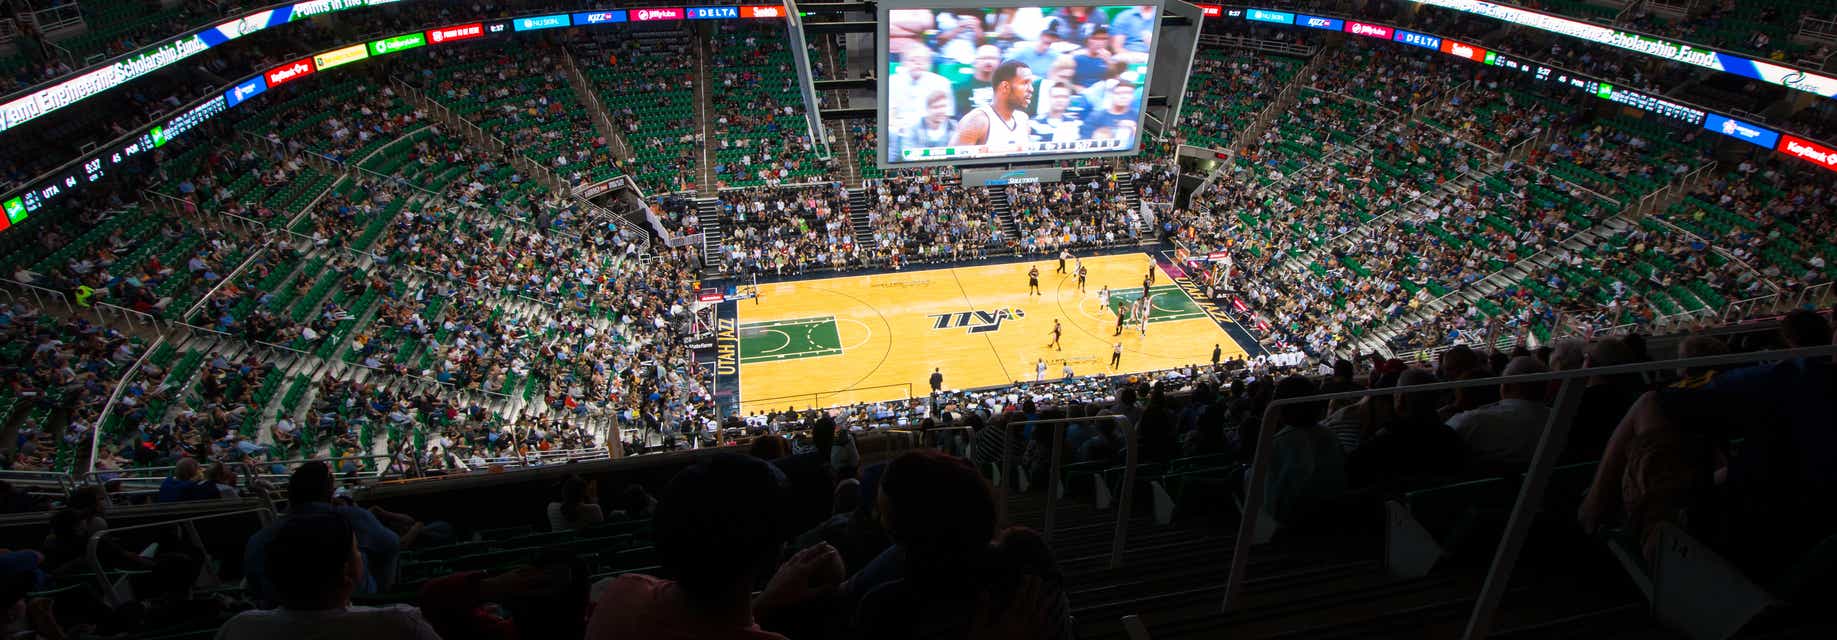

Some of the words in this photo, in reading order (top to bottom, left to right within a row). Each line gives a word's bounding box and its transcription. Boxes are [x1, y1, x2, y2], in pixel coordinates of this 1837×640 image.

[700, 8, 736, 17] DELTA
[1406, 33, 1438, 48] DELTA
[1605, 28, 1678, 58] Scholarship
[1680, 46, 1716, 67] Fund
[40, 70, 118, 112] Engineering
[115, 44, 179, 81] Scholarship
[125, 143, 140, 157] POR
[84, 158, 101, 174] 5:37
[65, 176, 77, 188] 64
[42, 185, 60, 199] UTA
[717, 317, 738, 341] JAZZ
[717, 344, 737, 375] UTAH
